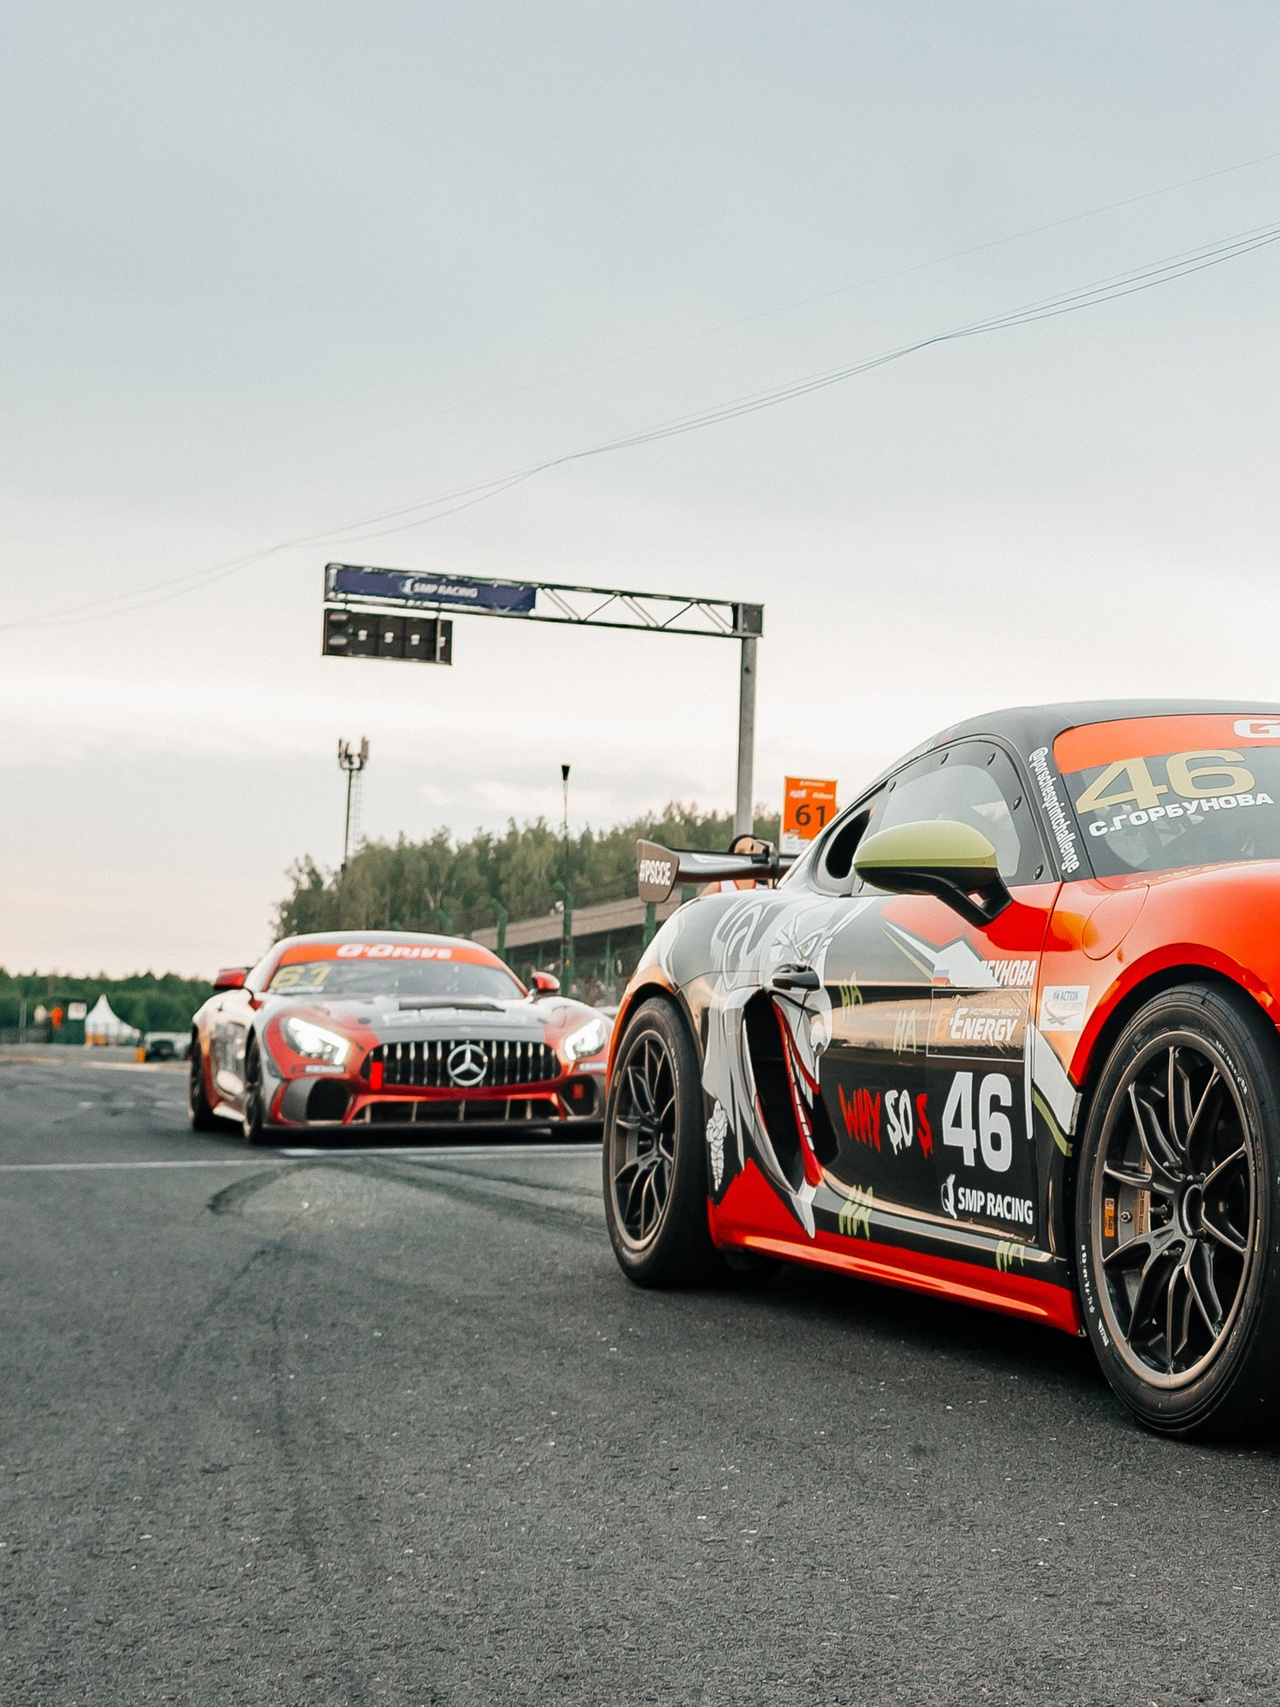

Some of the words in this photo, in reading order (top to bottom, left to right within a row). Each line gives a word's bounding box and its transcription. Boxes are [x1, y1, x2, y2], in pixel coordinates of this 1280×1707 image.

[795, 803, 826, 827] 61
[1028, 746, 1080, 874] @porschesprintchallenge
[1074, 749, 1256, 815] 46
[269, 964, 334, 989] 61
[838, 1085, 881, 1152] WHY
[884, 1089, 914, 1155] SO
[942, 1071, 1012, 1172] 46
[957, 1186, 986, 1214] SMP
[986, 1194, 1034, 1225] RACING
